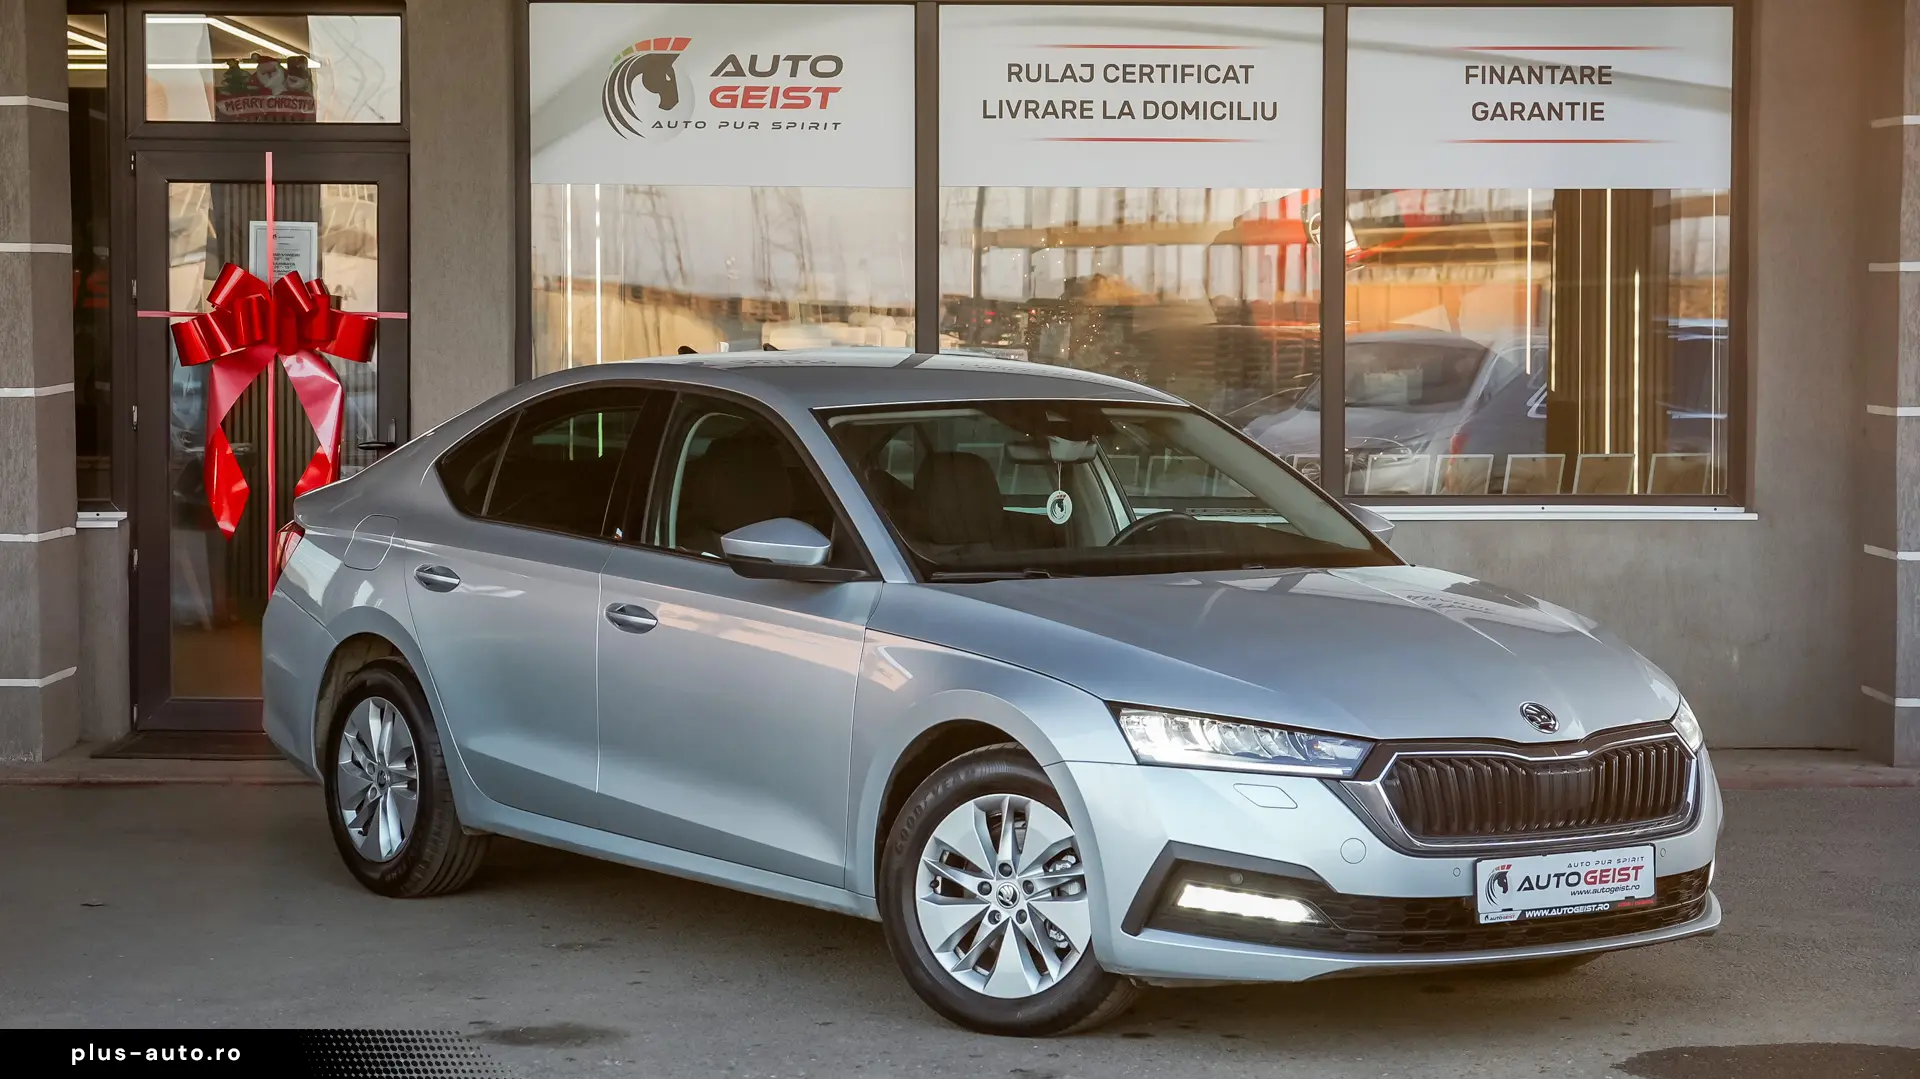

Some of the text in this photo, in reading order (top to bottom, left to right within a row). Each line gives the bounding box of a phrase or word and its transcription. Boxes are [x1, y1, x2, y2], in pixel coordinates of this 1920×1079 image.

[709, 54, 844, 78] AUTO
[1007, 62, 1255, 85] RULAJ CERTIFICAT
[1465, 64, 1613, 85] FINANTARE
[224, 97, 264, 112] MERRY
[709, 86, 843, 109] GEIST
[982, 99, 1278, 122] LIVRARE LA DOMICILIU
[1471, 101, 1605, 122] GARANTIE
[651, 120, 842, 131] AUTO PUR SPIRIT
[1566, 861, 1591, 869] AUTO
[1616, 856, 1645, 864] SPIRIT
[1570, 884, 1641, 897] www.autogeist.ro
[1525, 902, 1610, 919] WWW.AUTOGEIST.RO
